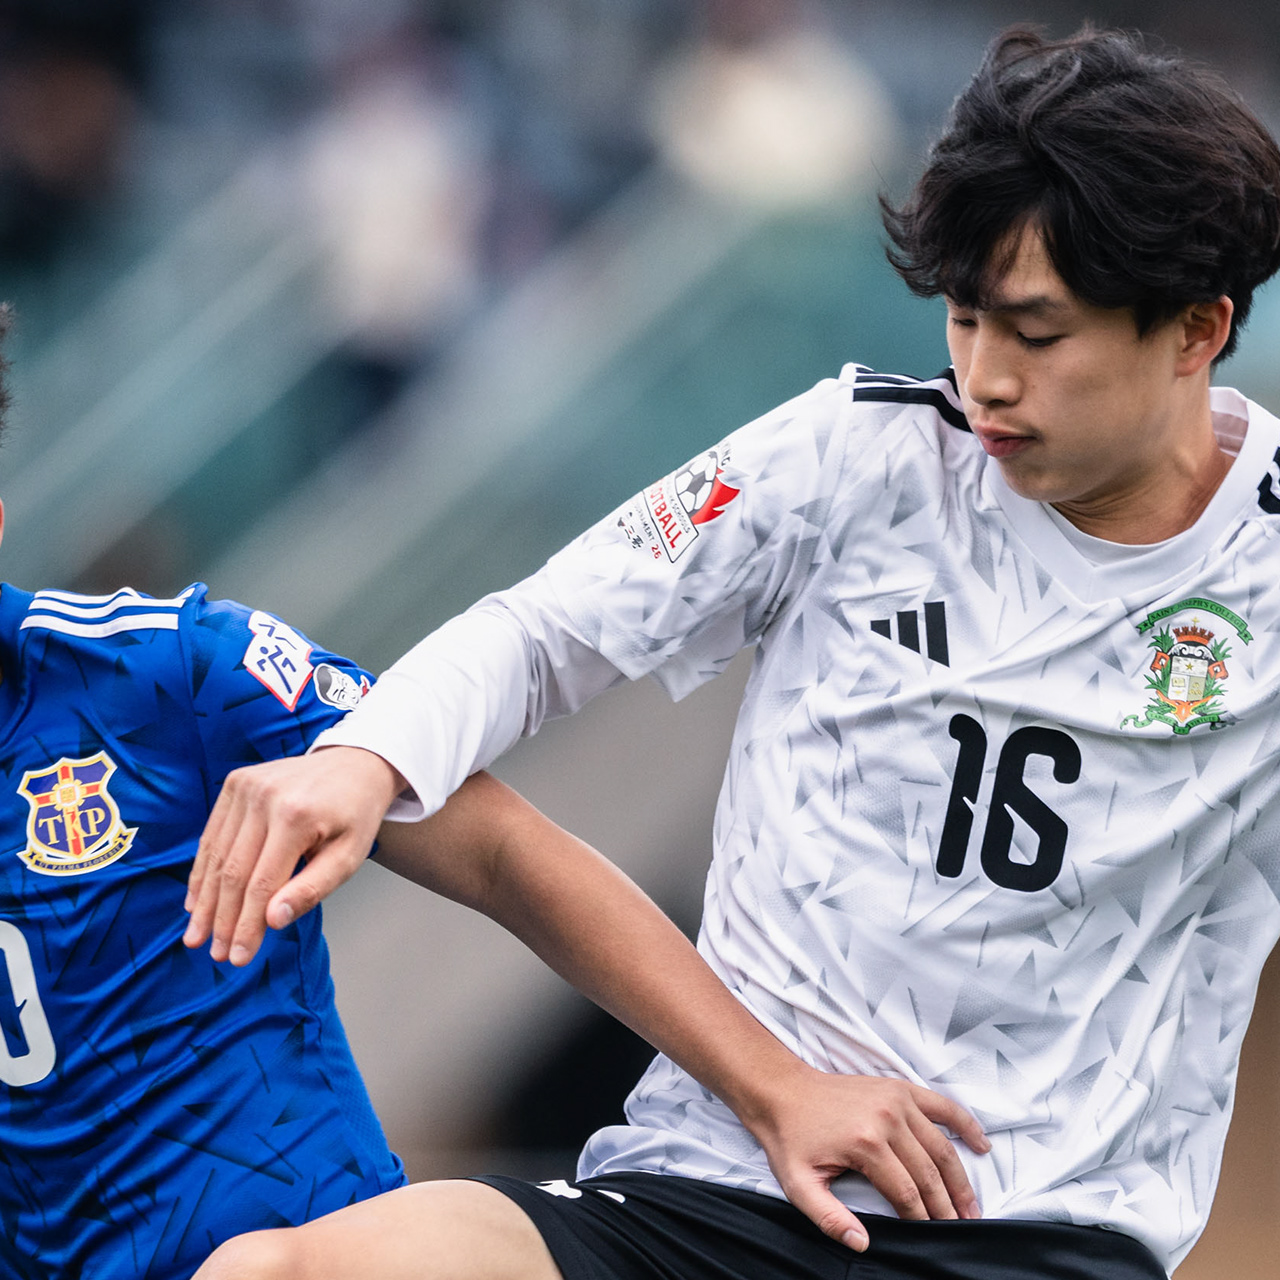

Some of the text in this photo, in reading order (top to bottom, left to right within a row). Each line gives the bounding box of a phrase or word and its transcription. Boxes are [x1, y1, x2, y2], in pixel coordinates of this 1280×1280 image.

[1150, 607, 1174, 620] SAINT
[1209, 604, 1245, 630] COLLEGE
[935, 713, 1082, 893] 16
[38, 807, 105, 845] TKP
